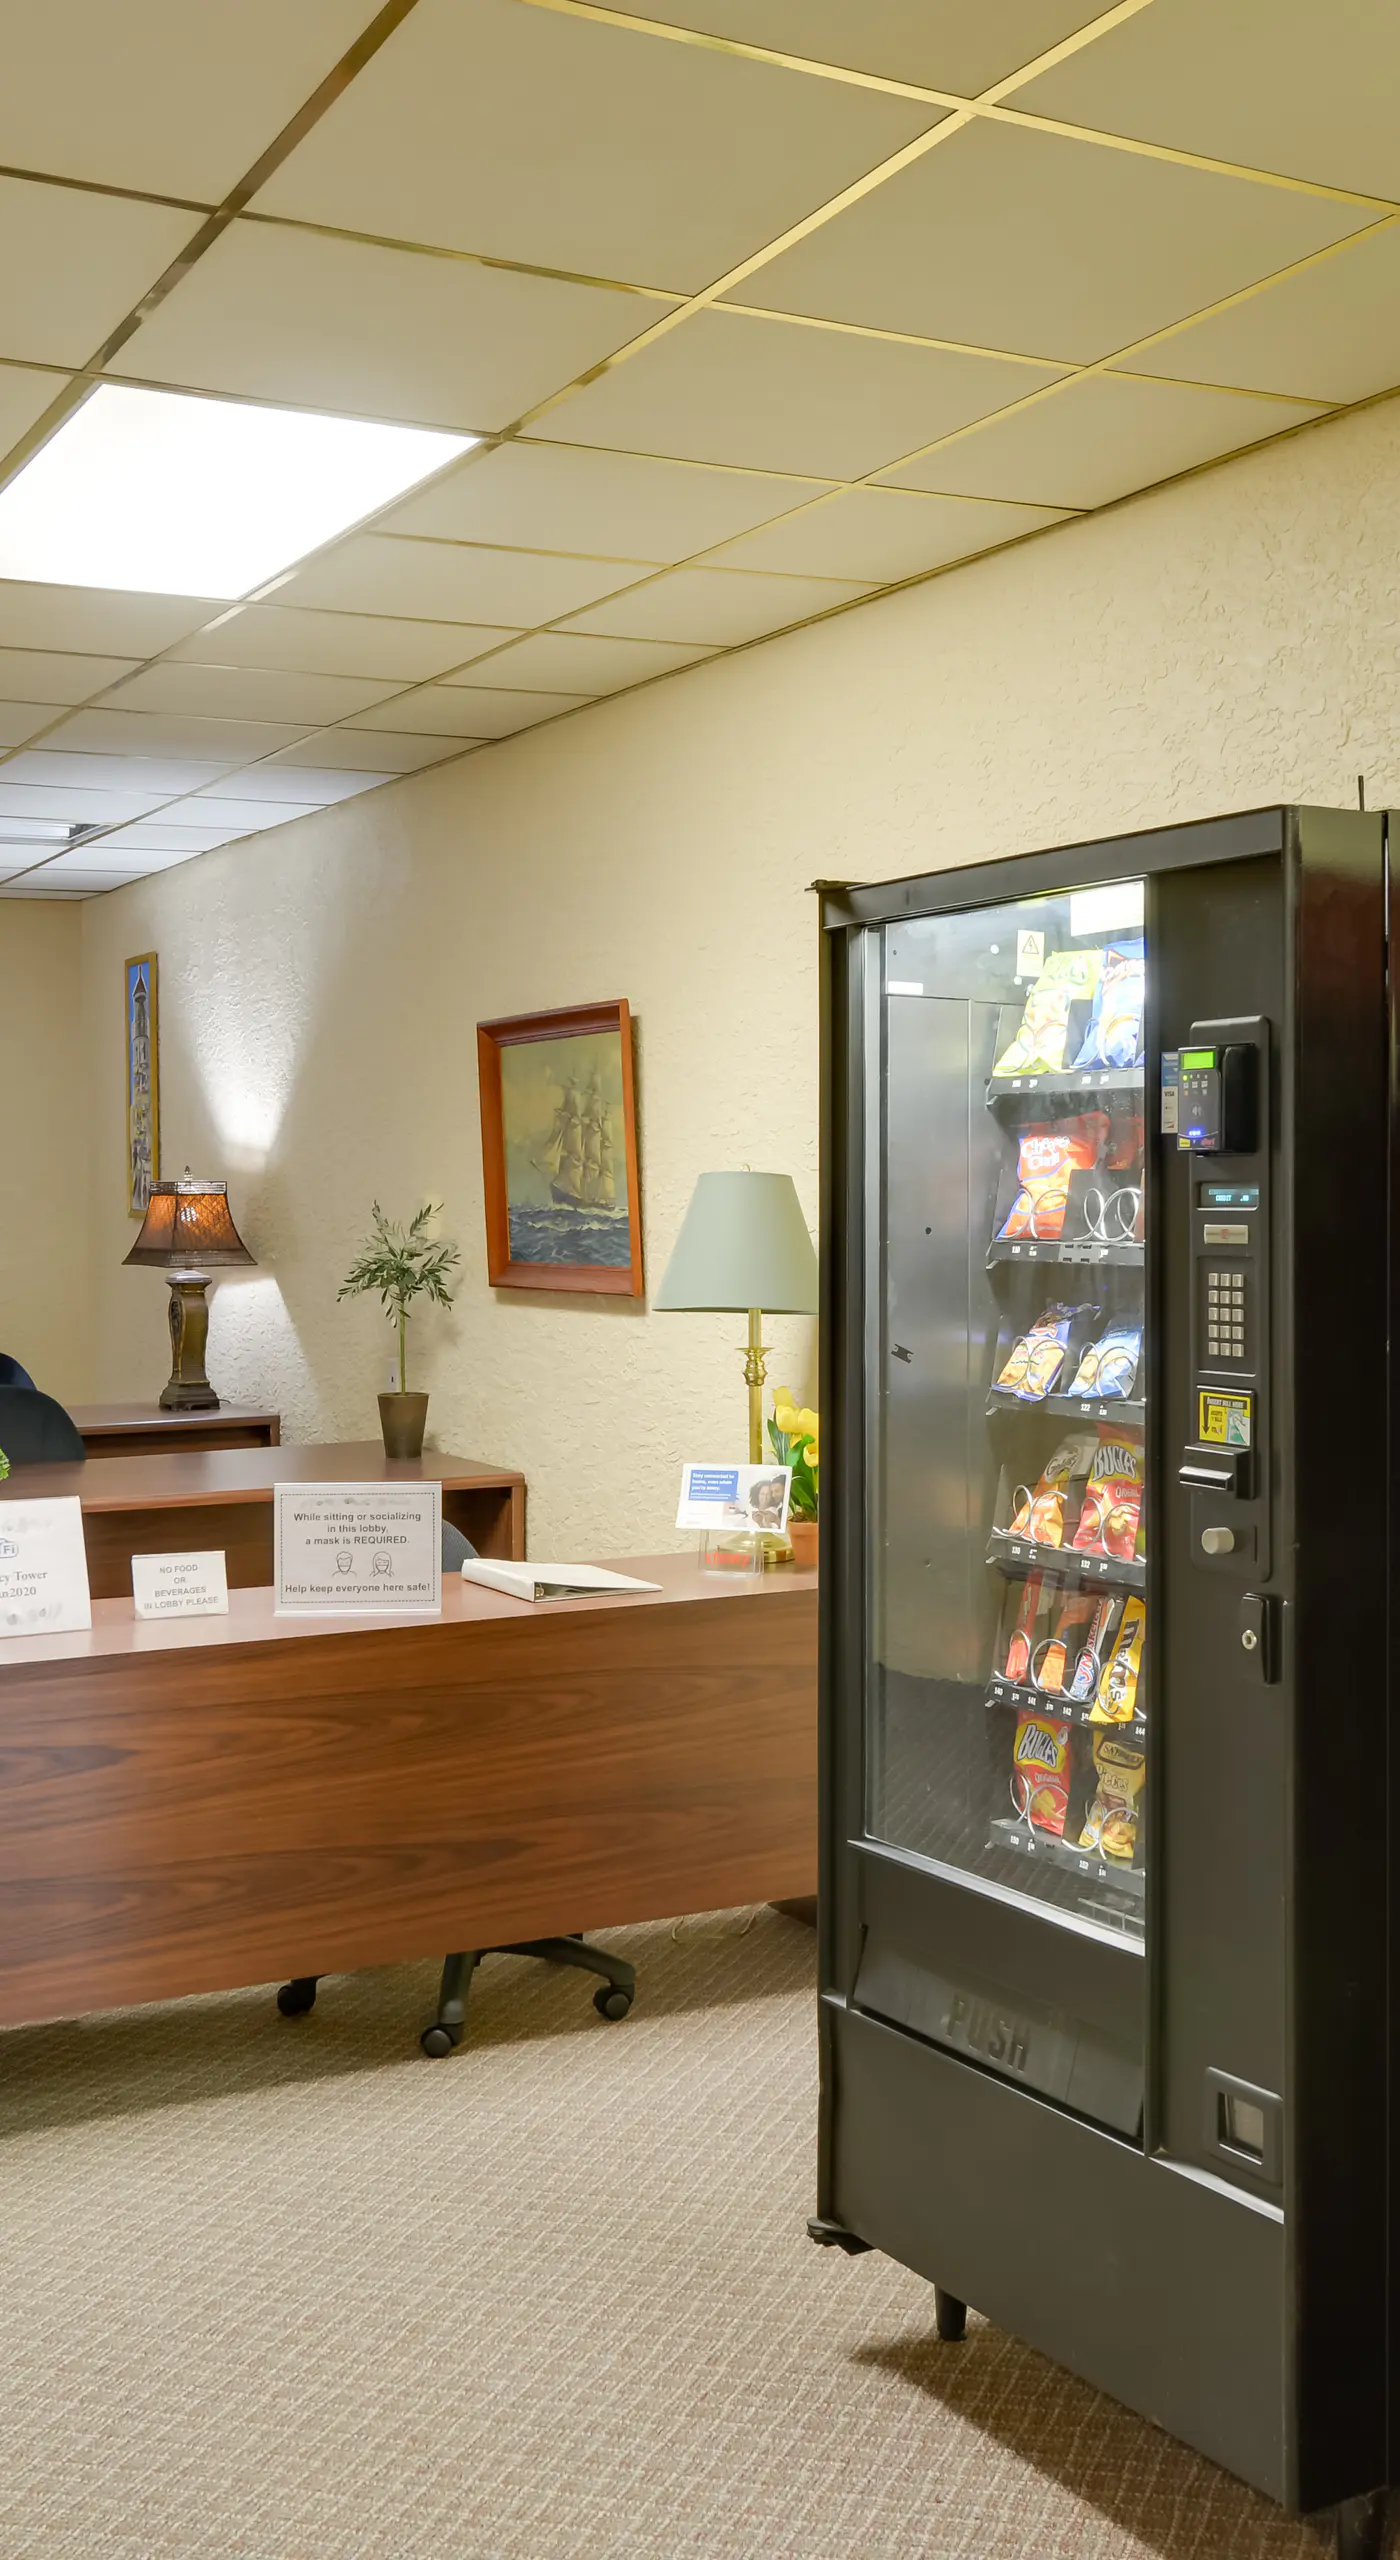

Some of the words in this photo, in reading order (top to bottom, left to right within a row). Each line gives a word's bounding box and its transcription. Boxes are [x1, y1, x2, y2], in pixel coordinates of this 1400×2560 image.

[1092, 1445, 1137, 1482] BUGLES
[294, 1512, 321, 1521] While
[324, 1512, 354, 1523] sitting
[357, 1513, 367, 1521] or
[370, 1511, 421, 1522] socializing
[327, 1525, 336, 1533] in
[339, 1524, 357, 1533] this
[314, 1536, 340, 1545] mask
[343, 1536, 351, 1545] is
[159, 1566, 172, 1574] NO
[174, 1564, 198, 1573] FOOD
[13, 1571, 48, 1581] Tower
[174, 1576, 186, 1584] OR
[154, 1586, 207, 1597] BEVERAGES
[285, 1584, 307, 1594] Help
[310, 1584, 333, 1593] keep
[336, 1584, 380, 1593] everyone
[383, 1583, 404, 1592] here
[407, 1582, 430, 1592] safe!
[155, 1600, 183, 1609] LOBBY
[186, 1596, 219, 1605] PLEASE
[1063, 1706, 1072, 1716] 142
[1018, 1723, 1058, 1769] BUGLES
[945, 1993, 1030, 2073] PUSH
